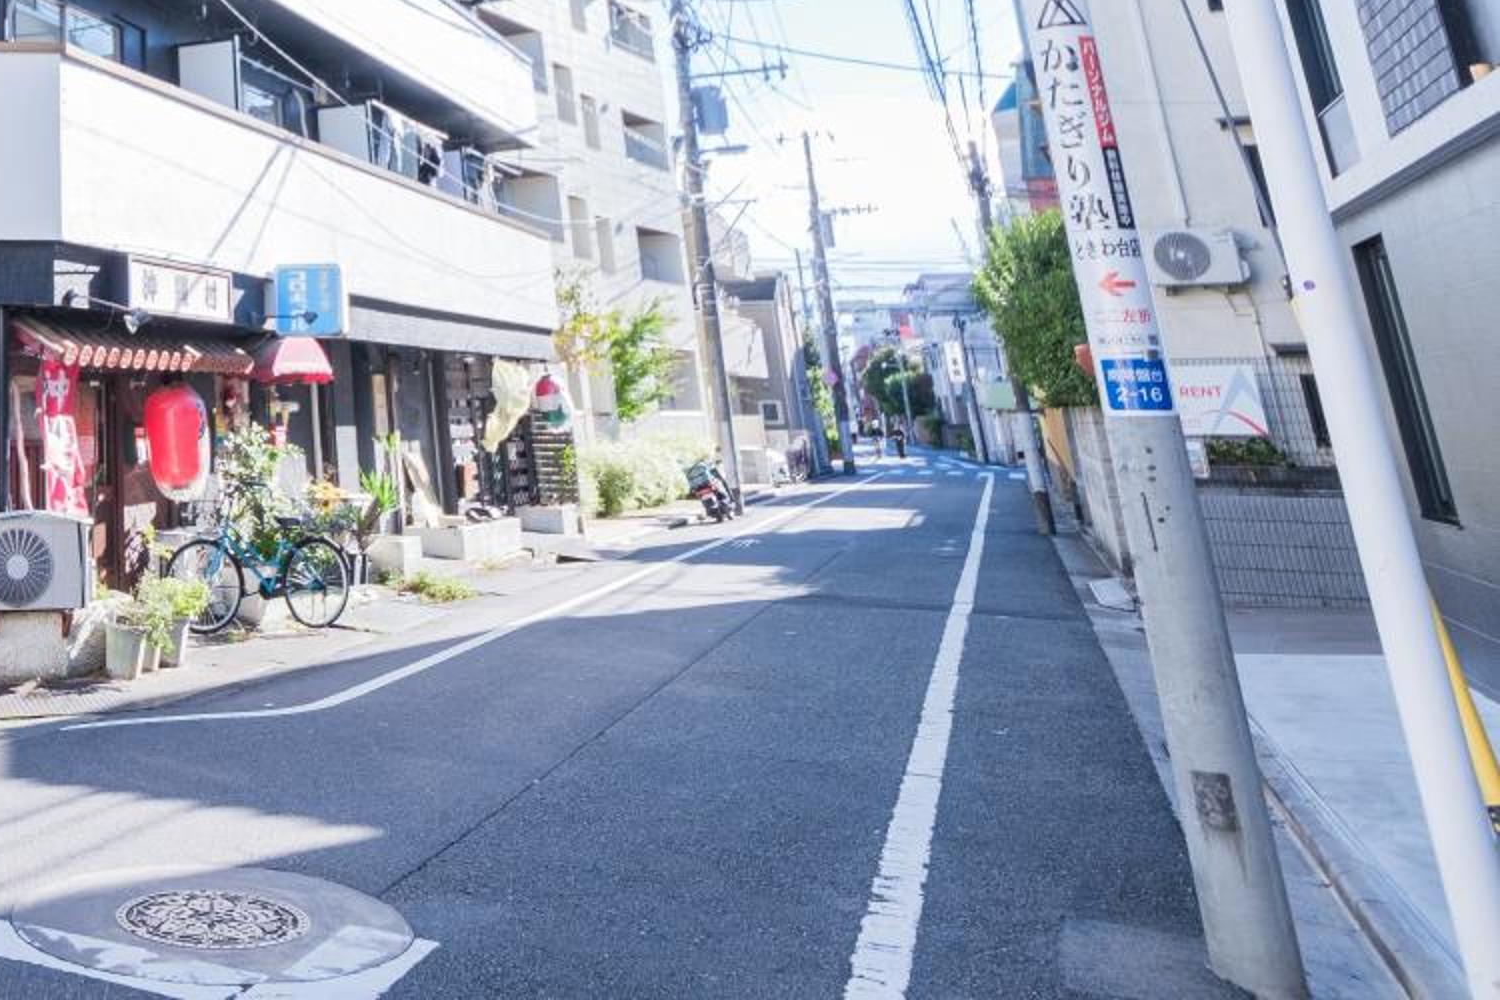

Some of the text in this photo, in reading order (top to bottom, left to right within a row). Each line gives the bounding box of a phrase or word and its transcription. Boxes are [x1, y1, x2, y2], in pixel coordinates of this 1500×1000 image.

[1041, 39, 1111, 231] かたぎり塾
[1115, 386, 1163, 402] 2-16
